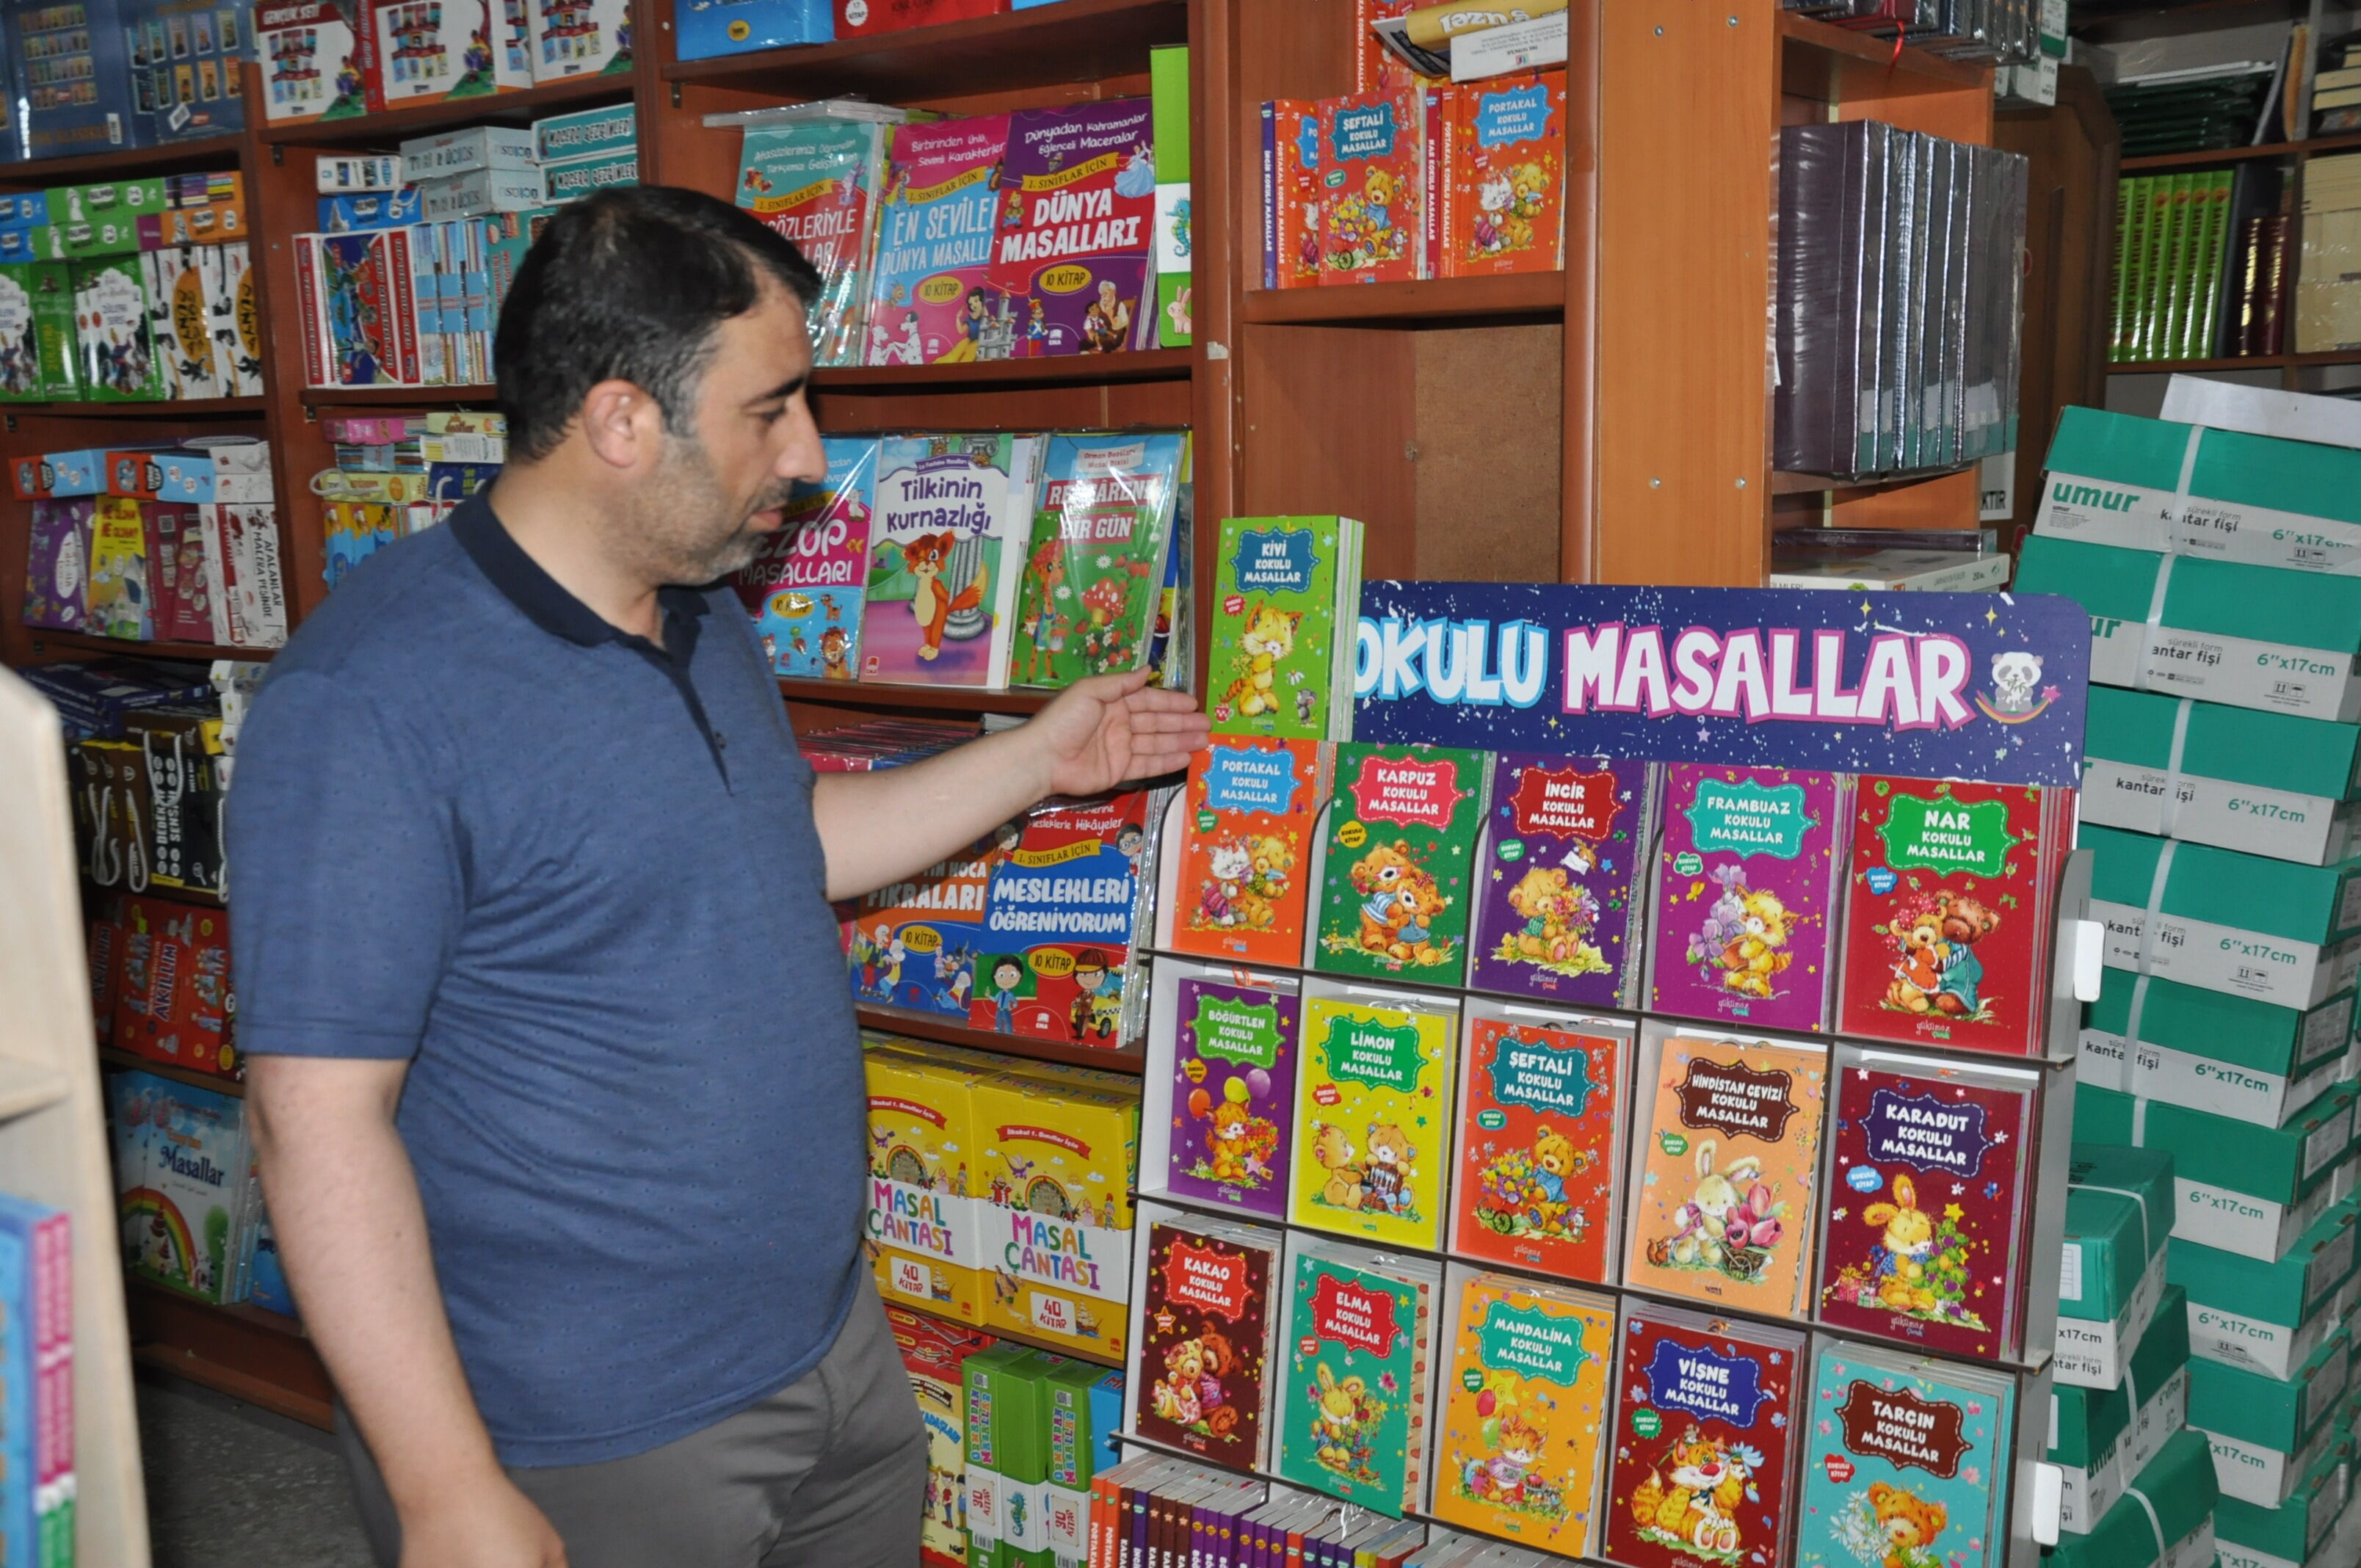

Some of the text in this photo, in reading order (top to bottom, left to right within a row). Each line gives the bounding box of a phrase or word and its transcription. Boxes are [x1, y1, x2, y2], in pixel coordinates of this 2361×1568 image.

[1489, 100, 1537, 114] PORTAKAL
[1343, 111, 1384, 131] ŞEFTALİ
[1497, 112, 1527, 125] KOKULU
[1025, 123, 1082, 145] Dünyadan
[1080, 130, 1138, 150] Maceralar
[1349, 129, 1378, 140] KOKULU
[1488, 123, 1534, 137] MASALLAR
[912, 135, 962, 153] Birbirinden
[948, 141, 1006, 164] Karakterler
[1341, 139, 1387, 153] MASALLAR
[1039, 168, 1084, 189] SINIFLAR
[1087, 158, 1107, 177] İÇİN
[766, 183, 824, 210] SINIFLAR İÇİN
[920, 181, 957, 201] SINIFLAR
[959, 172, 977, 190] İÇİN
[1033, 188, 1112, 227] DÜNYA
[893, 208, 920, 246] EN
[1000, 216, 1141, 264] MASALLARI
[881, 247, 926, 277] DÜNYA
[935, 278, 958, 297] KİTAP
[1045, 269, 1086, 286] 10 KİTAP
[901, 476, 983, 502] Tilkinin
[2053, 481, 2140, 512] umur
[2186, 505, 2241, 521] sürekli form
[1095, 514, 1133, 537] GÜN
[2213, 515, 2238, 534] fişi
[1261, 541, 1287, 558] KİVİ
[739, 560, 853, 587] MASALLARI
[1255, 558, 1292, 570] KOKULU
[1244, 570, 1302, 584] MASALLAR
[2167, 636, 2223, 653] sürekli form
[2197, 649, 2222, 667] fişi
[1563, 621, 1977, 731] MASALLAR
[1222, 760, 1281, 776] PORTAKAL
[1377, 769, 1437, 785] KARPUZ
[1231, 776, 1269, 791] KOKULU
[1382, 785, 1428, 800] KOKULU
[1545, 779, 1585, 799] İNCİR
[1219, 788, 1278, 804] MASALLAR
[1707, 796, 1791, 815] FRAMBUAZ
[1368, 799, 1440, 816] MASALLAR
[1542, 800, 1584, 815] KOKULU
[1075, 816, 1124, 836] Hikâyeler
[1528, 813, 1595, 830] MASALLAR
[1724, 814, 1771, 829] KOKULU
[1924, 810, 1970, 830] NAR
[1341, 828, 1363, 838] KOKULU
[1343, 835, 1360, 843] KİTAP
[1709, 827, 1783, 844] MASALLAR
[1921, 830, 1971, 847] KOKULU
[1027, 849, 1069, 865] SINIFLAR
[1070, 843, 1091, 857] İÇİN
[1906, 844, 1985, 863] MASALLAR
[953, 861, 987, 879] HOCA
[1871, 874, 1893, 882] KOKULU
[993, 871, 1130, 905] MESLEKLERİ
[1874, 881, 1890, 889] KİTAP
[868, 883, 986, 912] FIKRALARI
[989, 904, 1127, 933] ÖĞRENİYORUM
[904, 932, 938, 946] 10 KİTAP
[2161, 931, 2185, 948] fişi
[1034, 951, 1073, 971] 10 KİTAP
[1208, 1009, 1266, 1029] BÖĞÜRTLEN
[1218, 1026, 1254, 1042] KOKULU
[1350, 1028, 1395, 1051] LİMON
[1208, 1037, 1263, 1056] MASALLAR
[1352, 1050, 1392, 1066] KOKULU
[1509, 1049, 1573, 1076] ŞEFTALİ
[1340, 1061, 1403, 1081] MASALLAR
[1517, 1071, 1562, 1090] KOKULU
[1504, 1083, 1575, 1108] MASALLAR
[1691, 1073, 1782, 1103] HİNDİSTAN CEVİZİ
[1711, 1093, 1758, 1111] KOKULU
[1695, 1106, 1769, 1129] MASALLAR
[1885, 1104, 1969, 1133] KARADUT
[1898, 1126, 1952, 1147] KOKULU
[1881, 1138, 1968, 1166] MASALLAR
[159, 1144, 225, 1188] Masallar
[1851, 1170, 1877, 1182] KOKULU
[1856, 1180, 1875, 1189] KİTAP
[874, 1180, 947, 1227] MASAL
[868, 1208, 954, 1257] ÇANTASI
[1011, 1212, 1092, 1261] MASAL
[902, 1263, 919, 1281] 40
[1004, 1241, 1100, 1292] ÇANTASI
[1183, 1257, 1230, 1281] KAKAO
[899, 1277, 924, 1293] KİTAP
[1189, 1274, 1223, 1293] KOKULU
[1044, 1298, 1062, 1315] 40
[1178, 1285, 1231, 1308] MASALLAR
[1336, 1291, 1373, 1315] ELMA
[1040, 1313, 1067, 1329] KİTAP
[1335, 1307, 1371, 1329] KOKULU
[1324, 1318, 1381, 1346] MASALLAR
[1494, 1317, 1573, 1347] MANDALİNA
[1510, 1336, 1553, 1357] KOKULU
[1497, 1347, 1563, 1374] MASALLAR
[1678, 1356, 1730, 1384] VİŞNE
[2082, 1360, 2102, 1376] fişi
[1679, 1379, 1727, 1400] KOKULU
[1664, 1387, 1739, 1416] MASALLAR
[1871, 1400, 1935, 1430] TARÇIN
[1876, 1420, 1926, 1445] KOKULU
[1861, 1431, 1940, 1463] MASALLAR
[973, 1490, 984, 1509] 30
